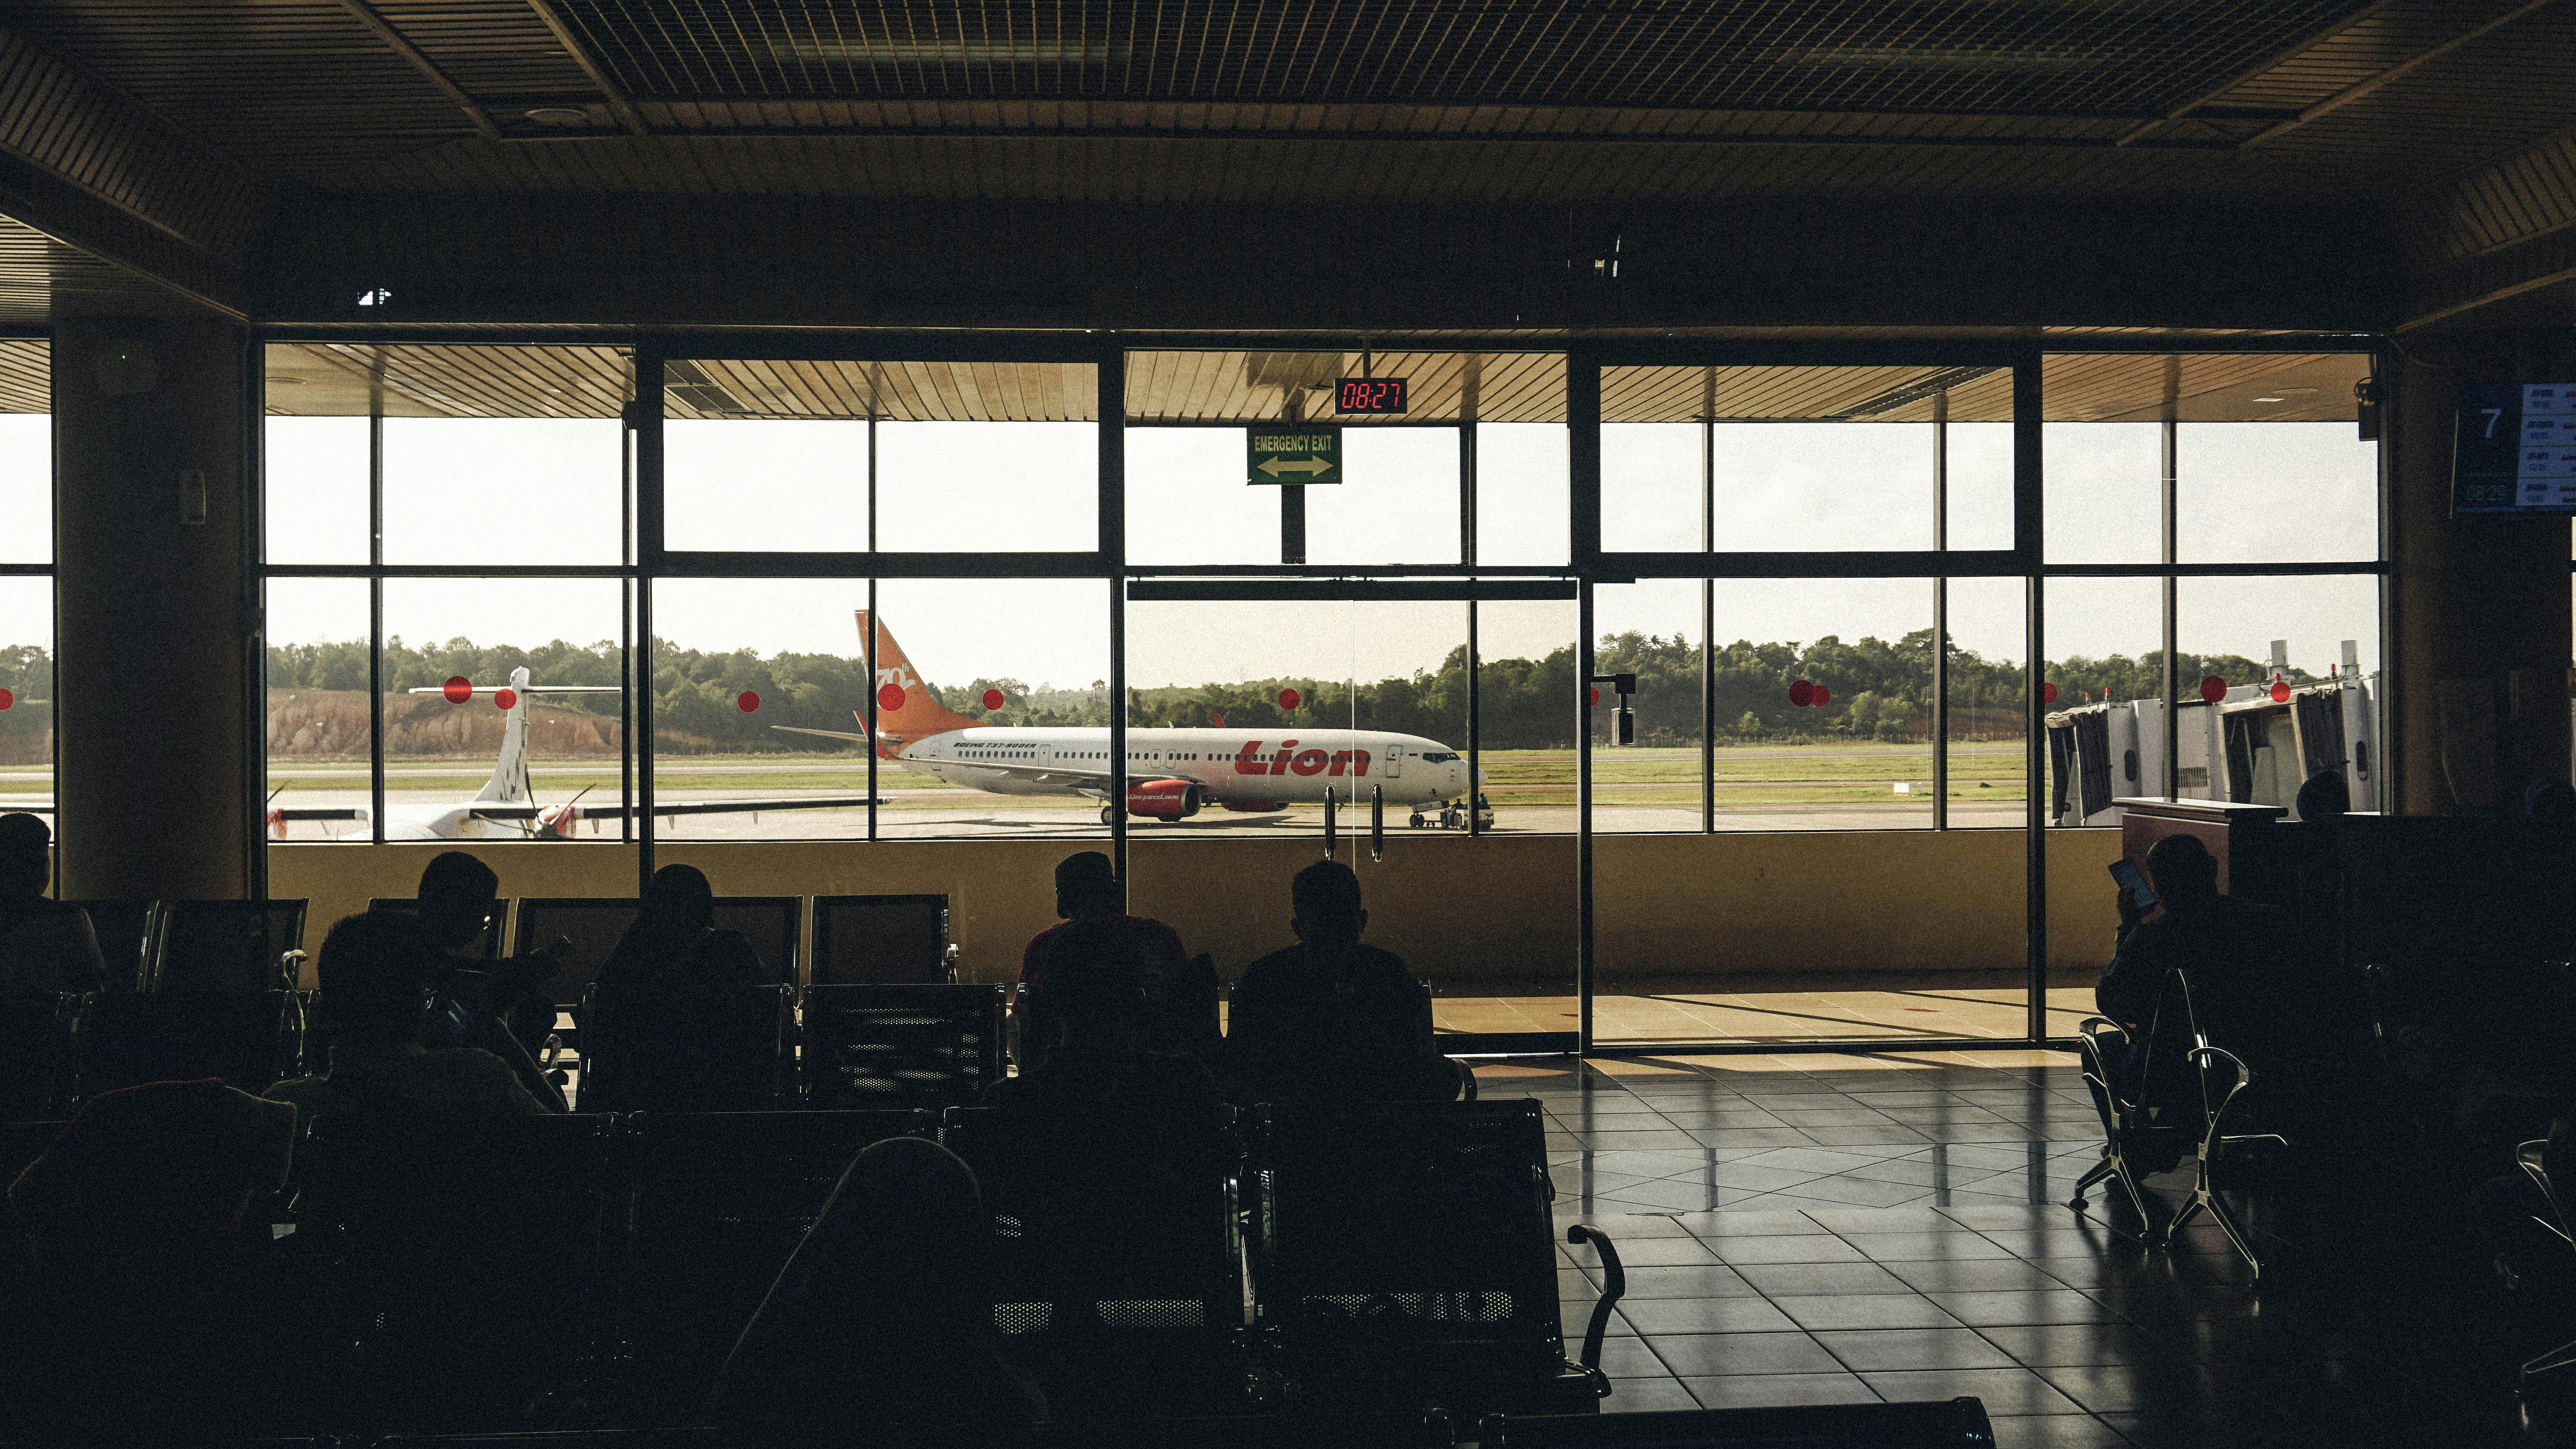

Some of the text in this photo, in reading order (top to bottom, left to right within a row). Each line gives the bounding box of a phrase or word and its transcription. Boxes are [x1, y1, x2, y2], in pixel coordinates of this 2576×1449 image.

[1342, 383, 1400, 409] 08:27
[2481, 408, 2502, 439] 7
[1255, 434, 1332, 452] EMERGENCY EXIT
[1234, 739, 1371, 777] Lion
